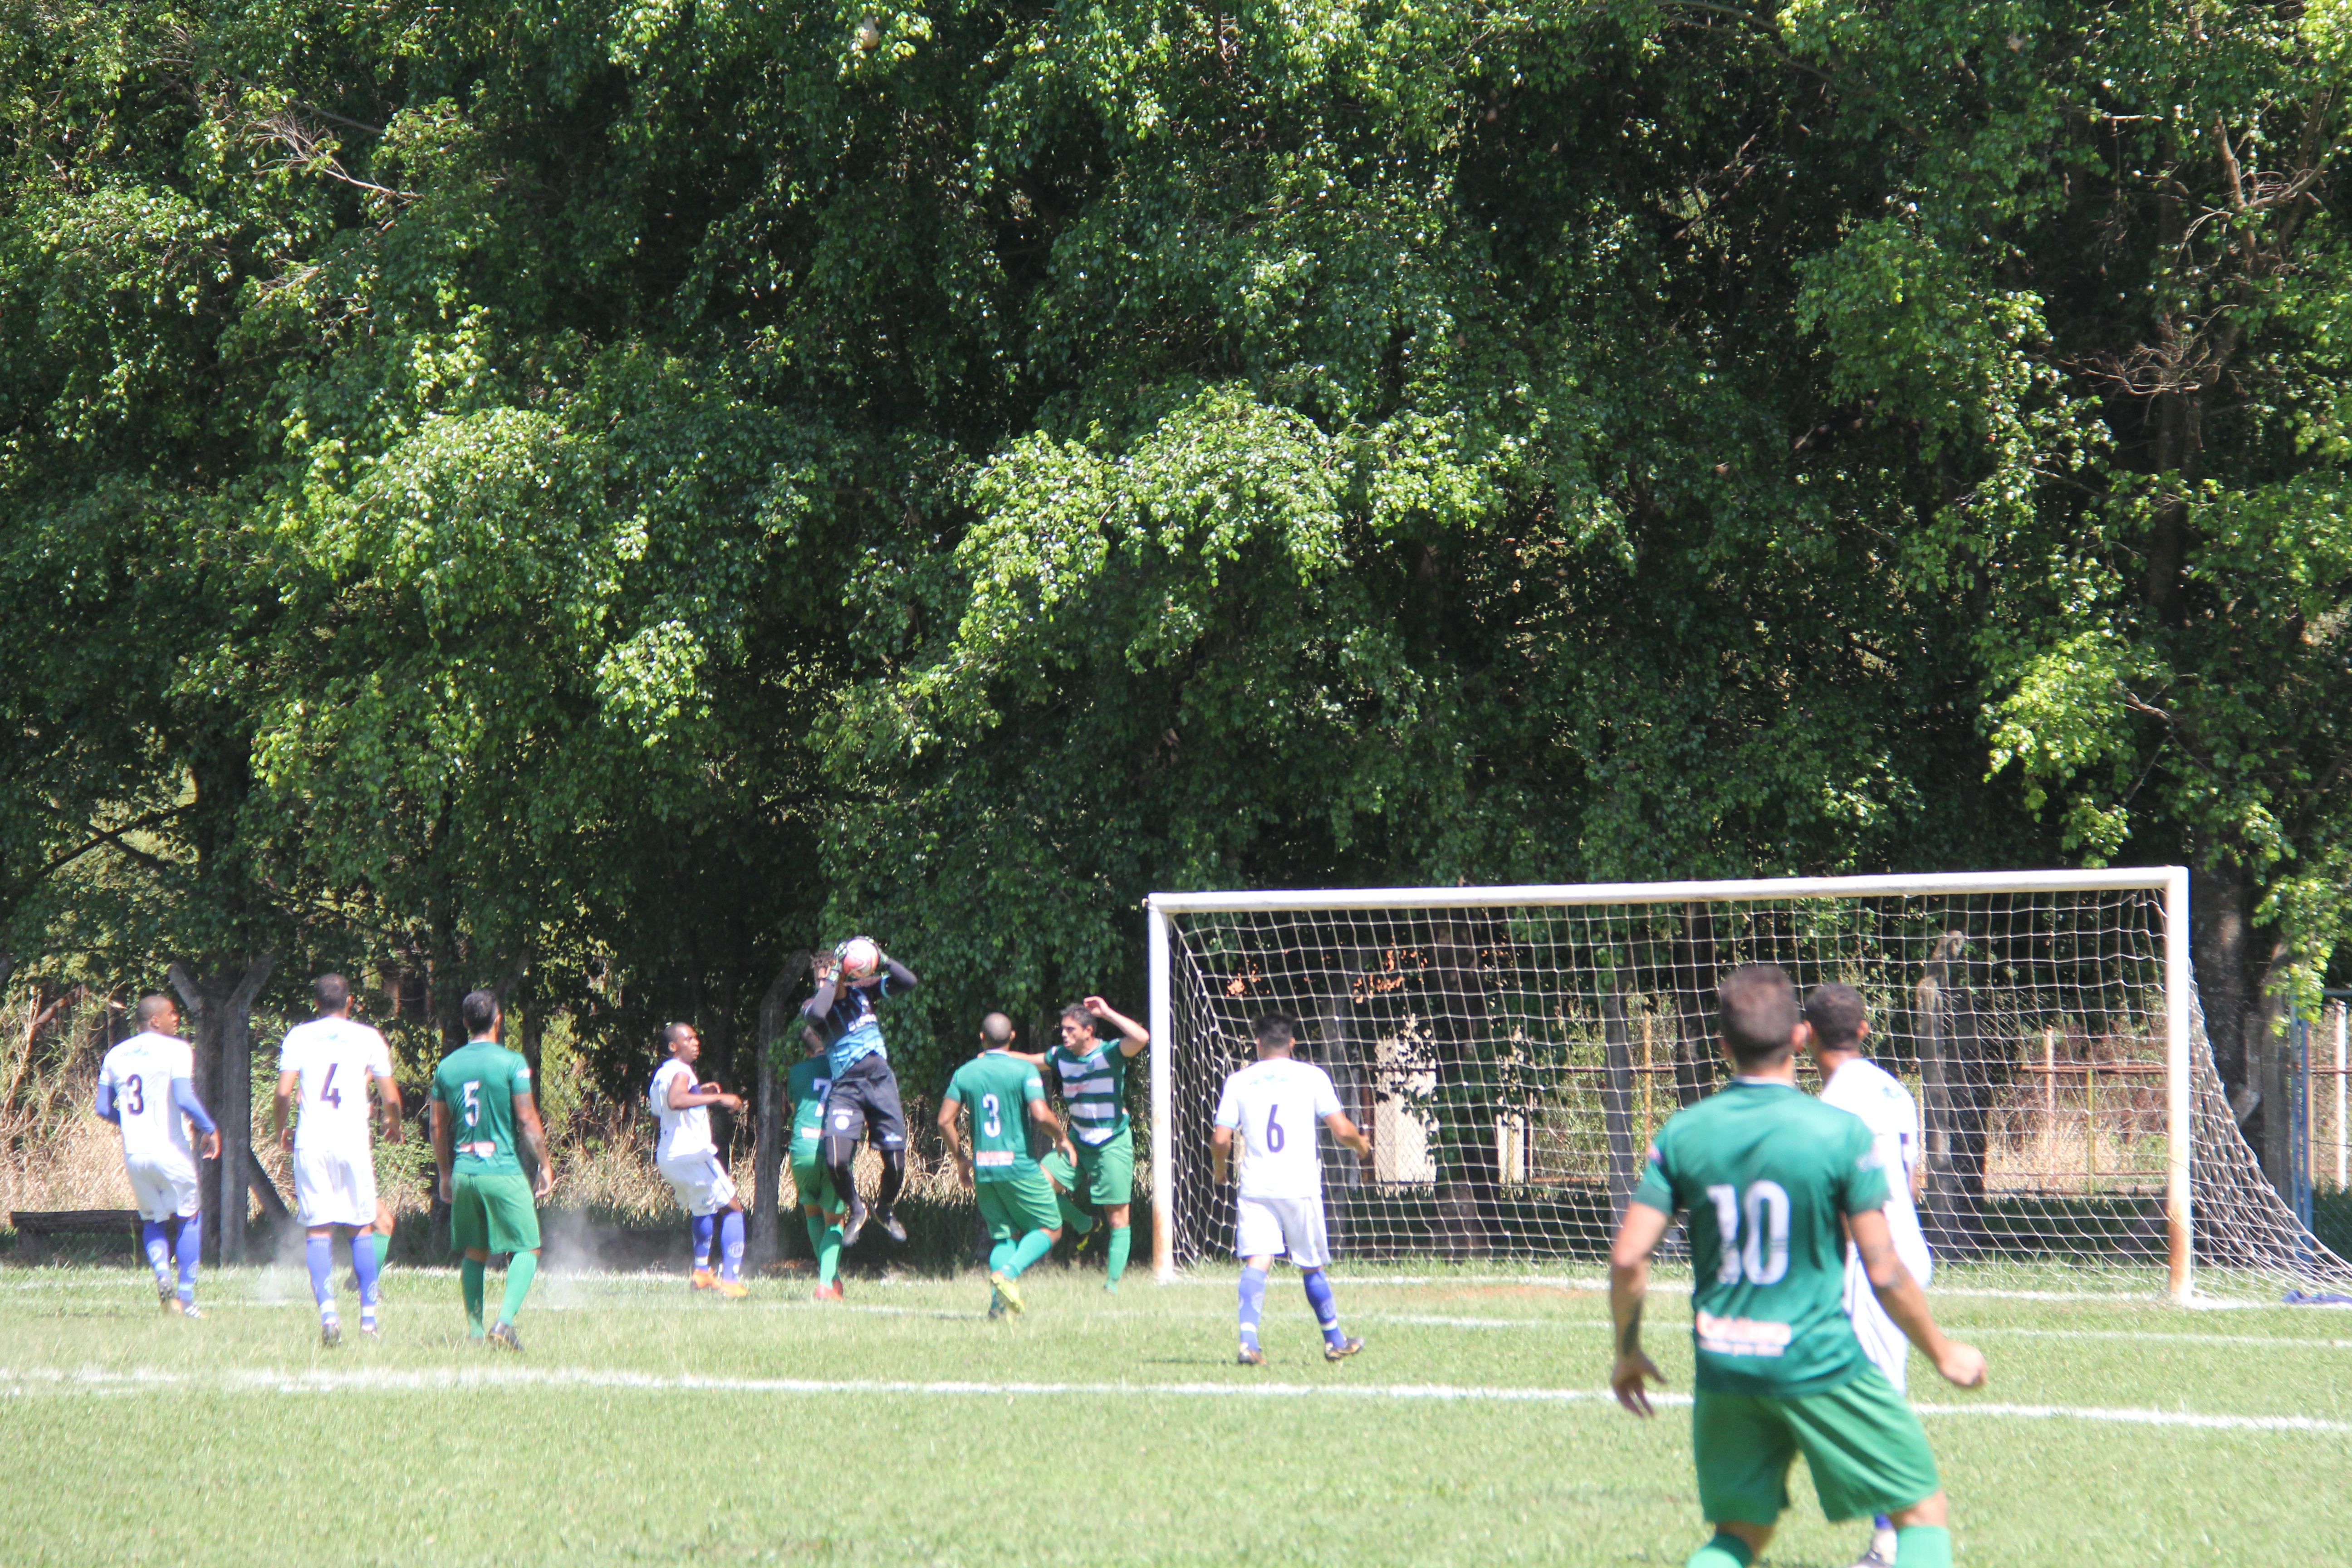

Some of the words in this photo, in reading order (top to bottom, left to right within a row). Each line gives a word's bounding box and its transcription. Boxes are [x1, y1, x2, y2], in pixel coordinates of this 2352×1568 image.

[127, 1074, 144, 1116] 3
[320, 1063, 341, 1110] 4
[463, 1080, 480, 1127] 5
[813, 1078, 832, 1117] 7
[982, 1093, 1001, 1137] 3
[1266, 1104, 1284, 1153] 6
[1706, 1181, 1790, 1285] 10
